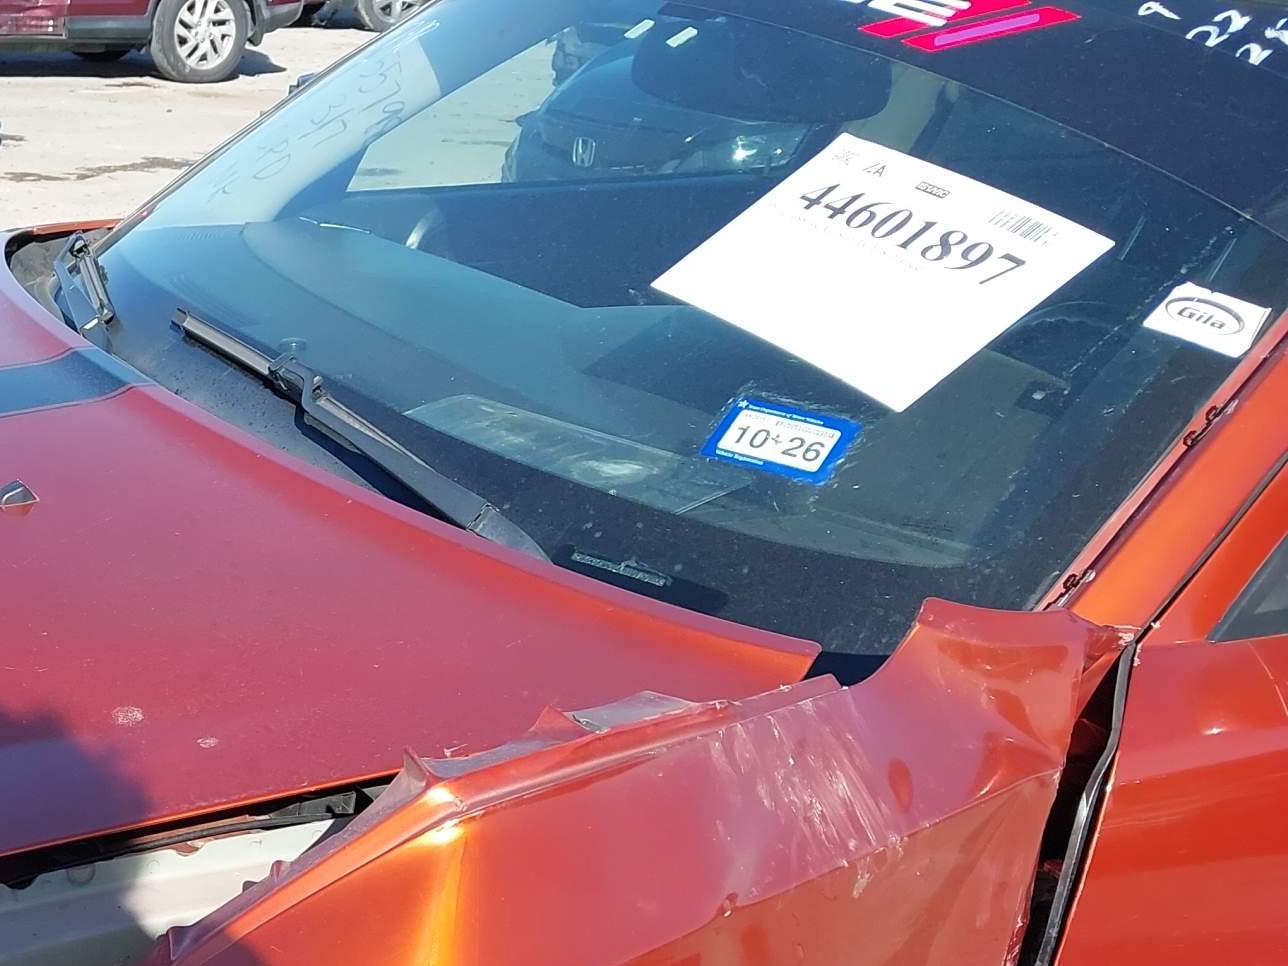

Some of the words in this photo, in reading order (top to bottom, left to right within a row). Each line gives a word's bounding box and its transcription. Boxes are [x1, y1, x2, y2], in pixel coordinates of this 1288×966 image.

[800, 183, 1026, 285] 44601897
[1176, 306, 1227, 330] Gila
[734, 425, 770, 449] 10
[780, 436, 826, 463] 26
